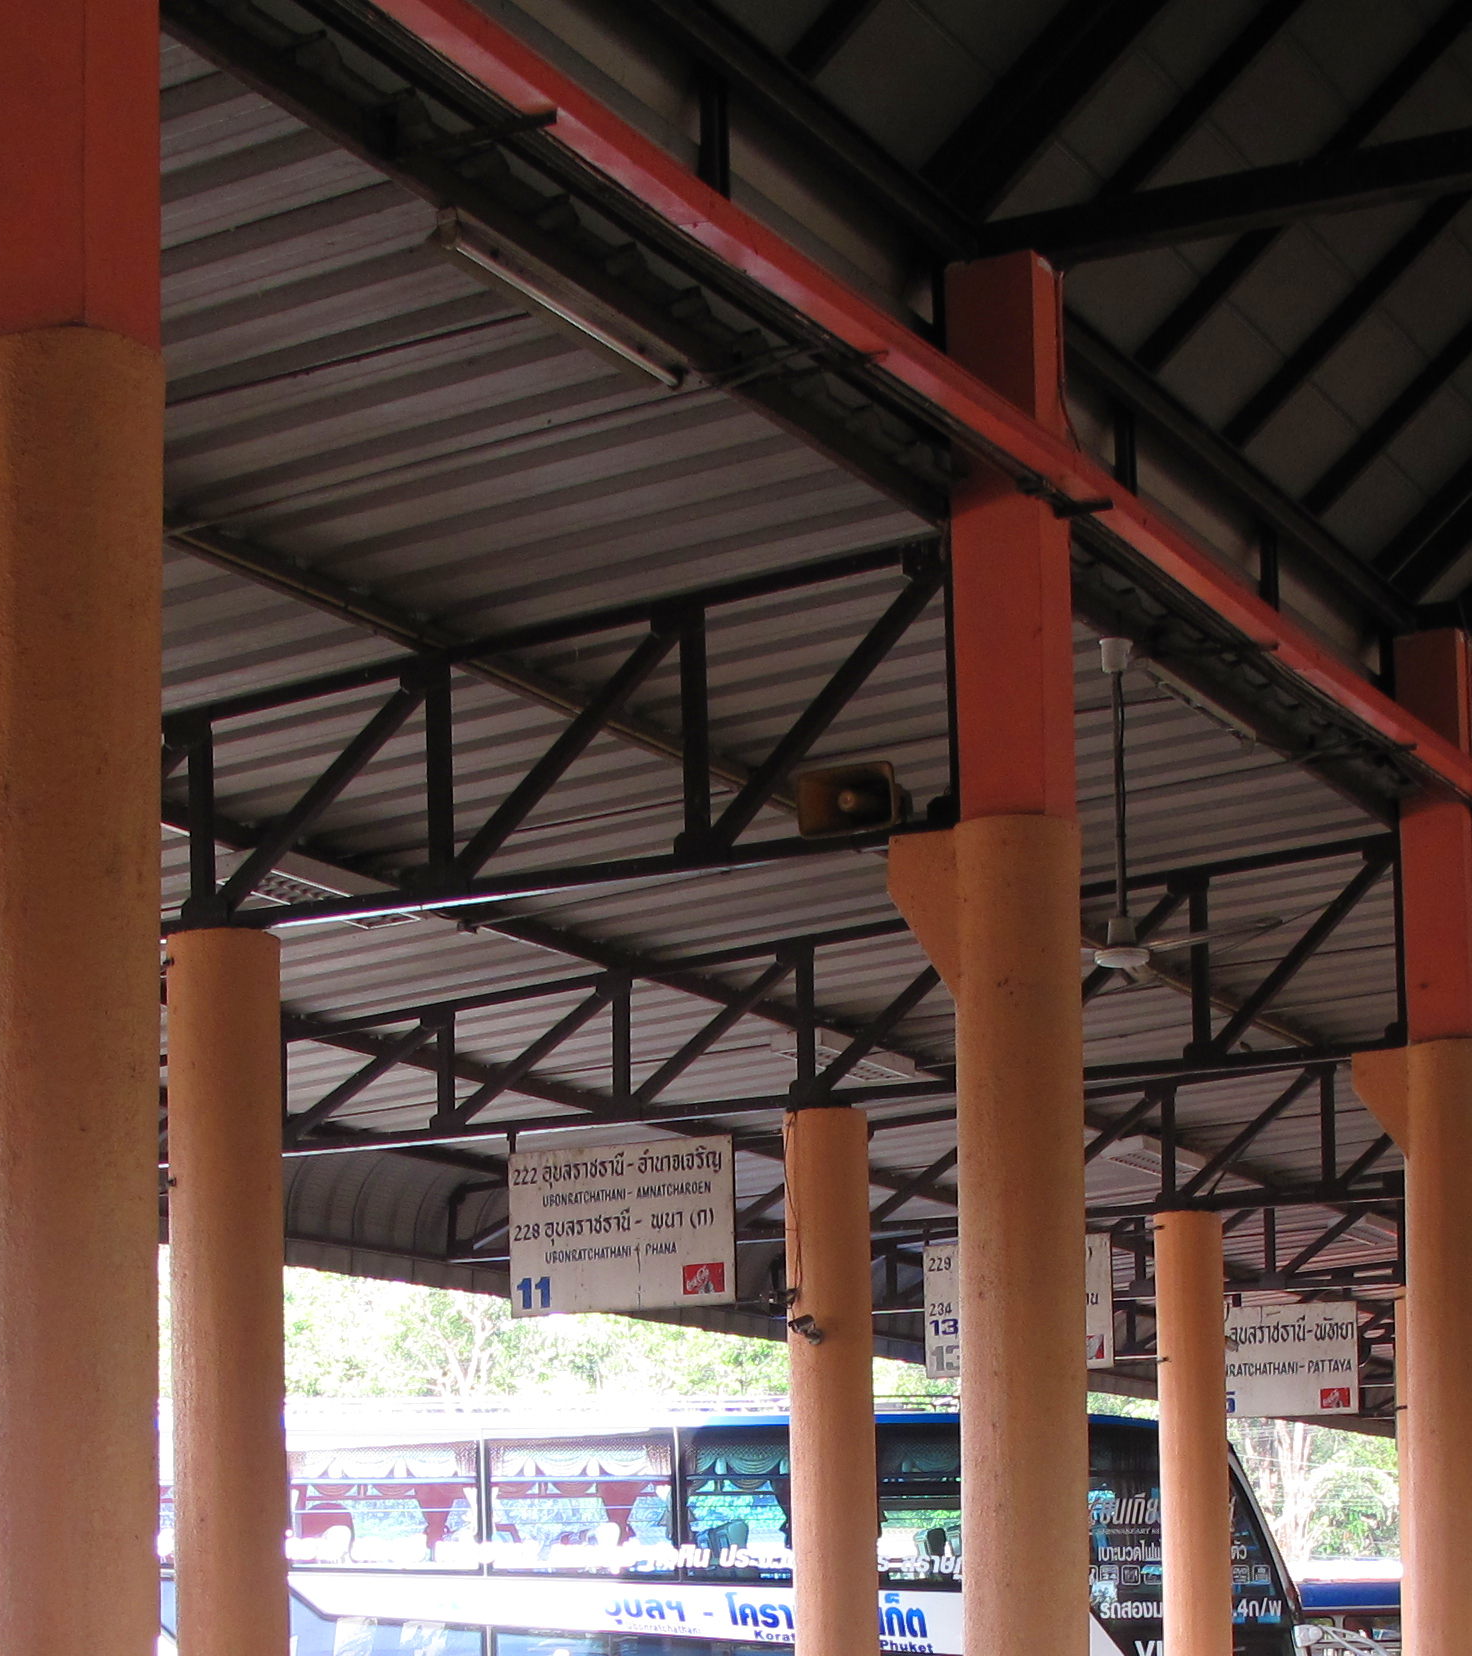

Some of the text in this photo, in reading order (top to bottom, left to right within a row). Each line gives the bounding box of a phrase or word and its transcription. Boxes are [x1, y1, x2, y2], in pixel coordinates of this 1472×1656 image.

[513, 1167, 538, 1186] 222
[514, 1222, 540, 1242] 228
[645, 1241, 677, 1255] PHANA
[928, 1257, 951, 1272] 229
[516, 1277, 551, 1310] 11
[929, 1302, 952, 1317] 234
[929, 1318, 958, 1336] 13
[725, 1592, 795, 1629] โครา
[880, 1640, 933, 1654] Phuket
